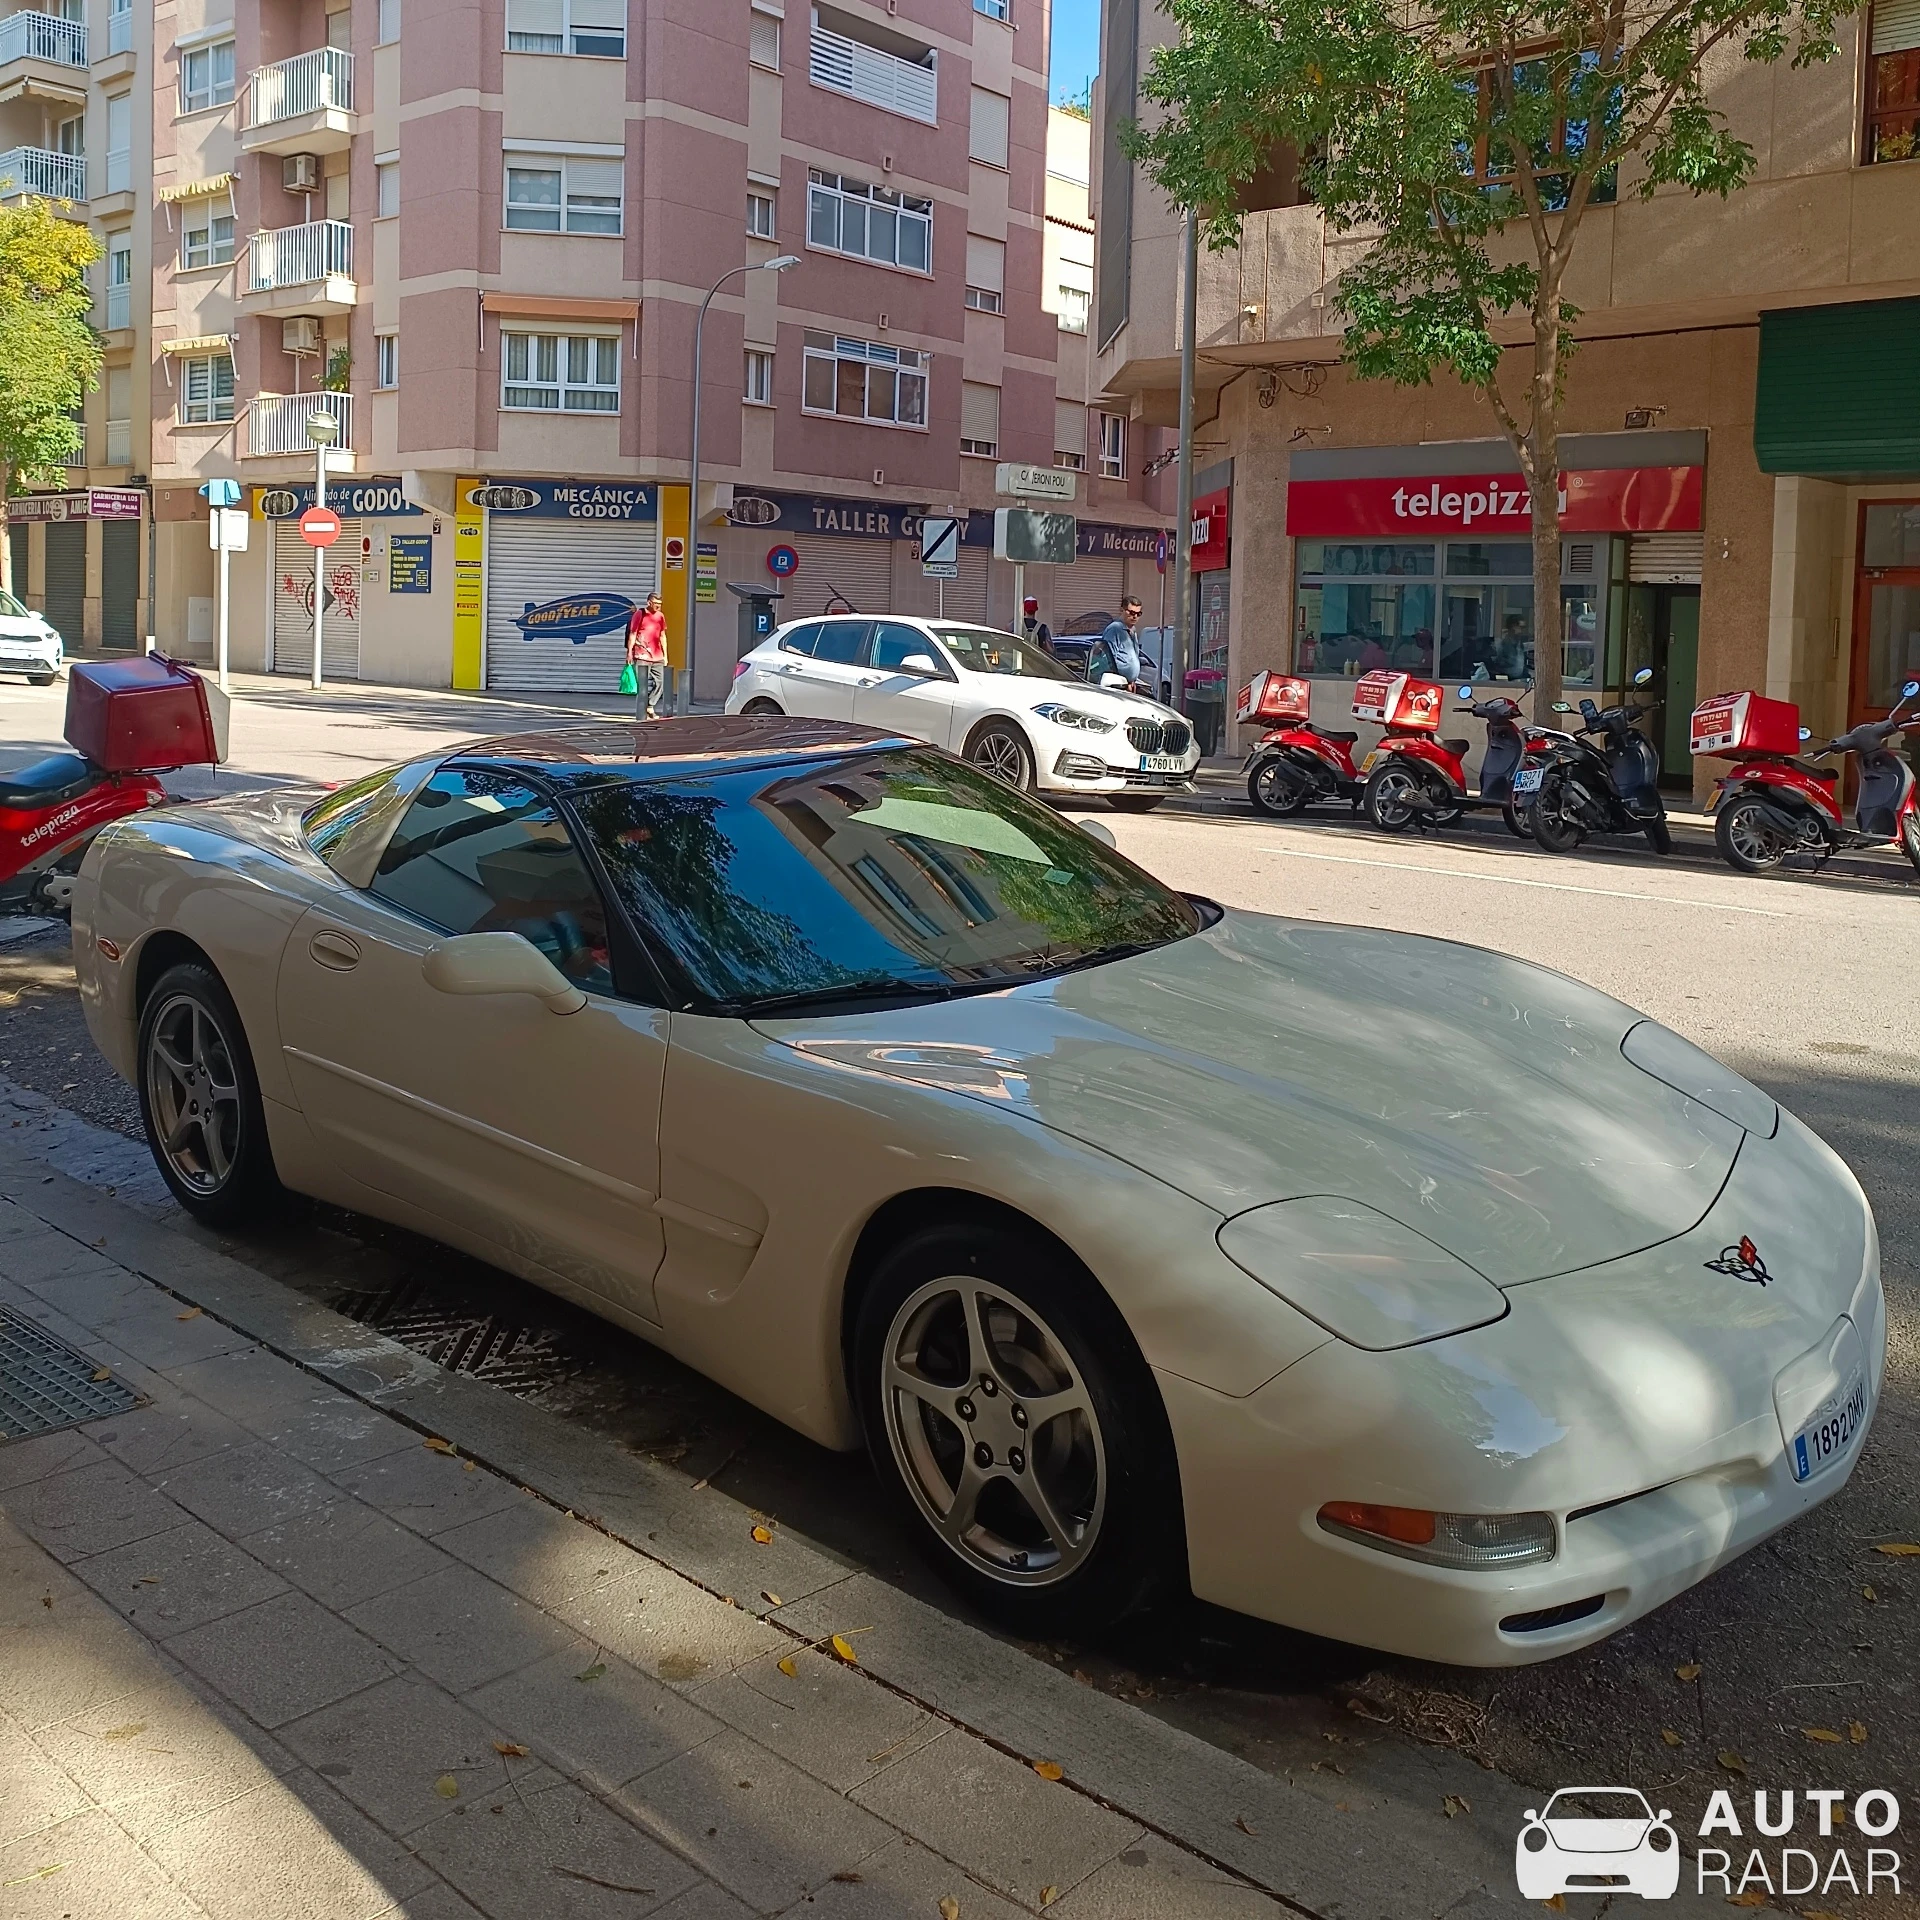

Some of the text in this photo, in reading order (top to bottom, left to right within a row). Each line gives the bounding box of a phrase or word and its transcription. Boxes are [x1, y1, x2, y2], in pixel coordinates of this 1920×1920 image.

[1052, 475, 1065, 487] POU
[340, 487, 350, 500] de
[553, 485, 648, 504] MECÁNICA
[8, 501, 41, 516] CARNICERIA
[70, 499, 90, 514] AMIG
[568, 504, 633, 518] GODOY
[812, 507, 890, 533] TALLER
[1087, 535, 1096, 552] y
[780, 557, 786, 565] P
[527, 603, 601, 625] GOODYEAR
[758, 615, 767, 629] P
[1708, 736, 1716, 749] 19
[1147, 757, 1183, 771] 4760 LVY
[1522, 770, 1541, 781] 9071
[20, 805, 81, 848] telepizza
[1800, 1382, 1864, 1472] E 1892 DMV
